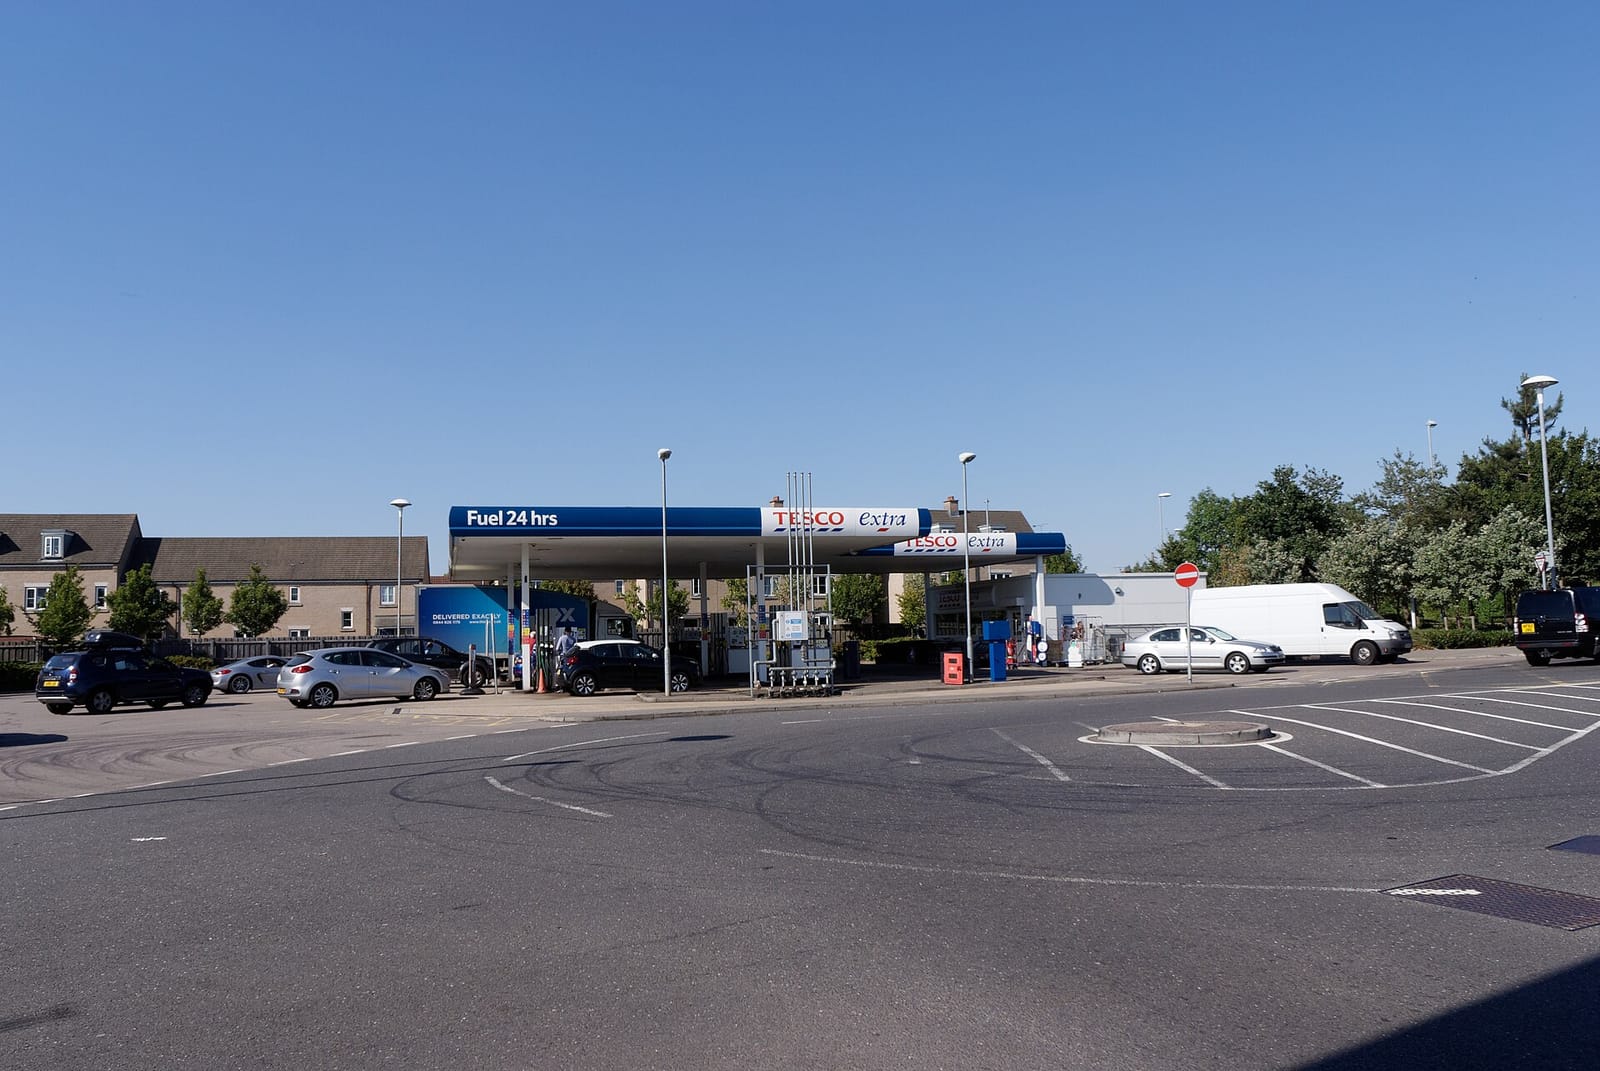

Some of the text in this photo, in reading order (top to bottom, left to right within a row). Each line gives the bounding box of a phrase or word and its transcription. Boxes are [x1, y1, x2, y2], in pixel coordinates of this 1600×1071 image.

[467, 510, 558, 525] Fuel 24 hrs
[773, 511, 906, 526] TESCO extra
[968, 536, 1004, 547] extra
